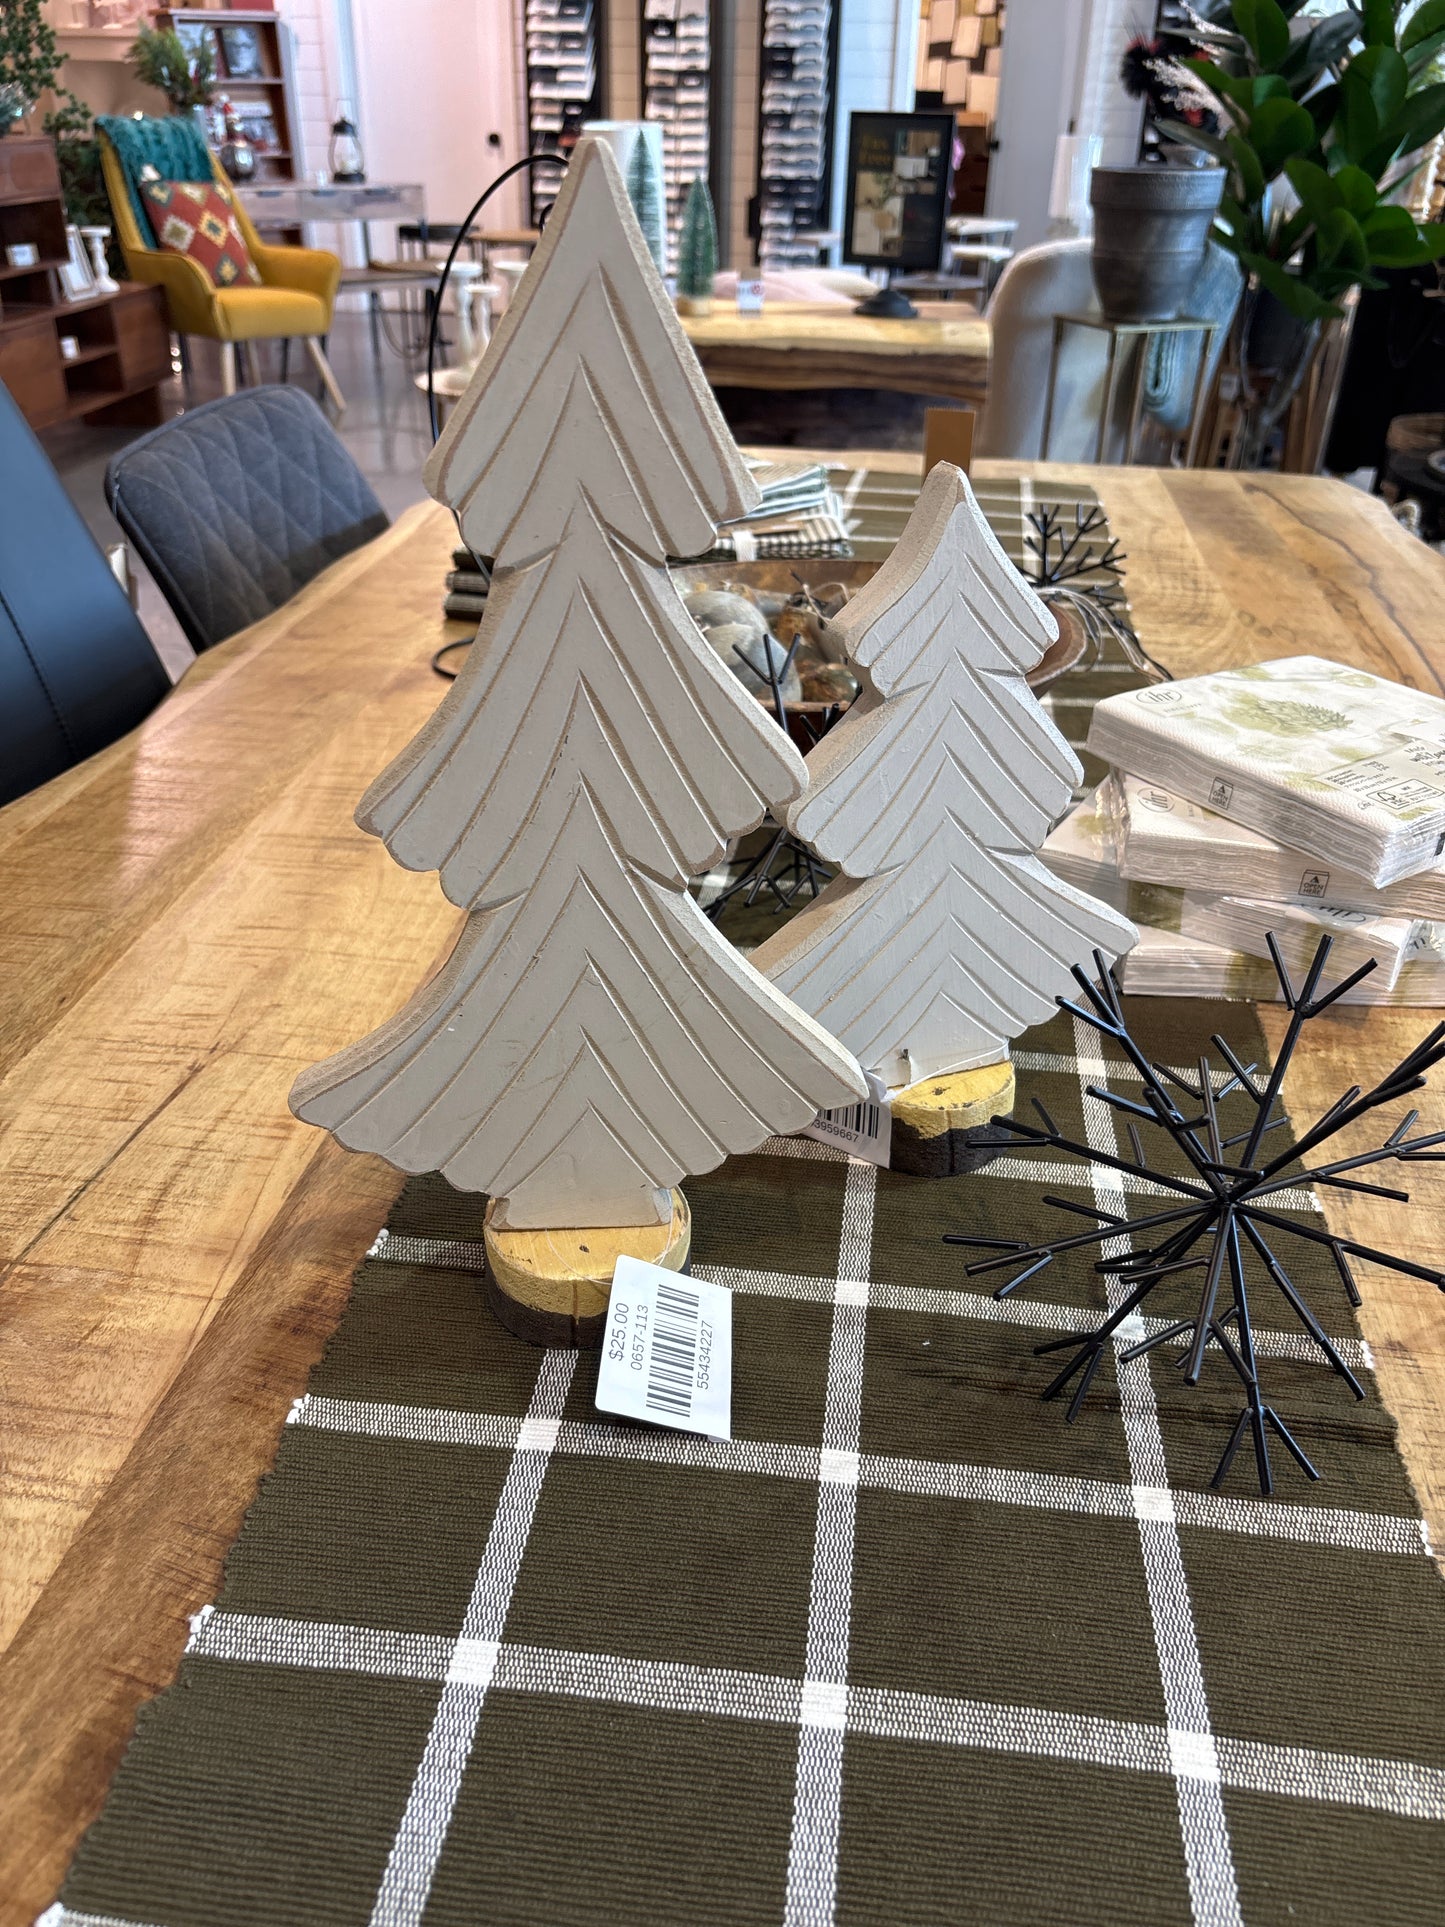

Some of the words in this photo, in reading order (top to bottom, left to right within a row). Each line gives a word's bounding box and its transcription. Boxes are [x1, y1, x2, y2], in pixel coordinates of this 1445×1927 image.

[1212, 790, 1228, 802] OPEN
[1303, 882, 1323, 891] OPEN
[1303, 888, 1320, 896] HERE
[811, 1119, 859, 1142] 3959667
[608, 1302, 629, 1362] $25.00
[630, 1304, 649, 1371] 0657-113
[696, 1320, 713, 1390] 55434227
